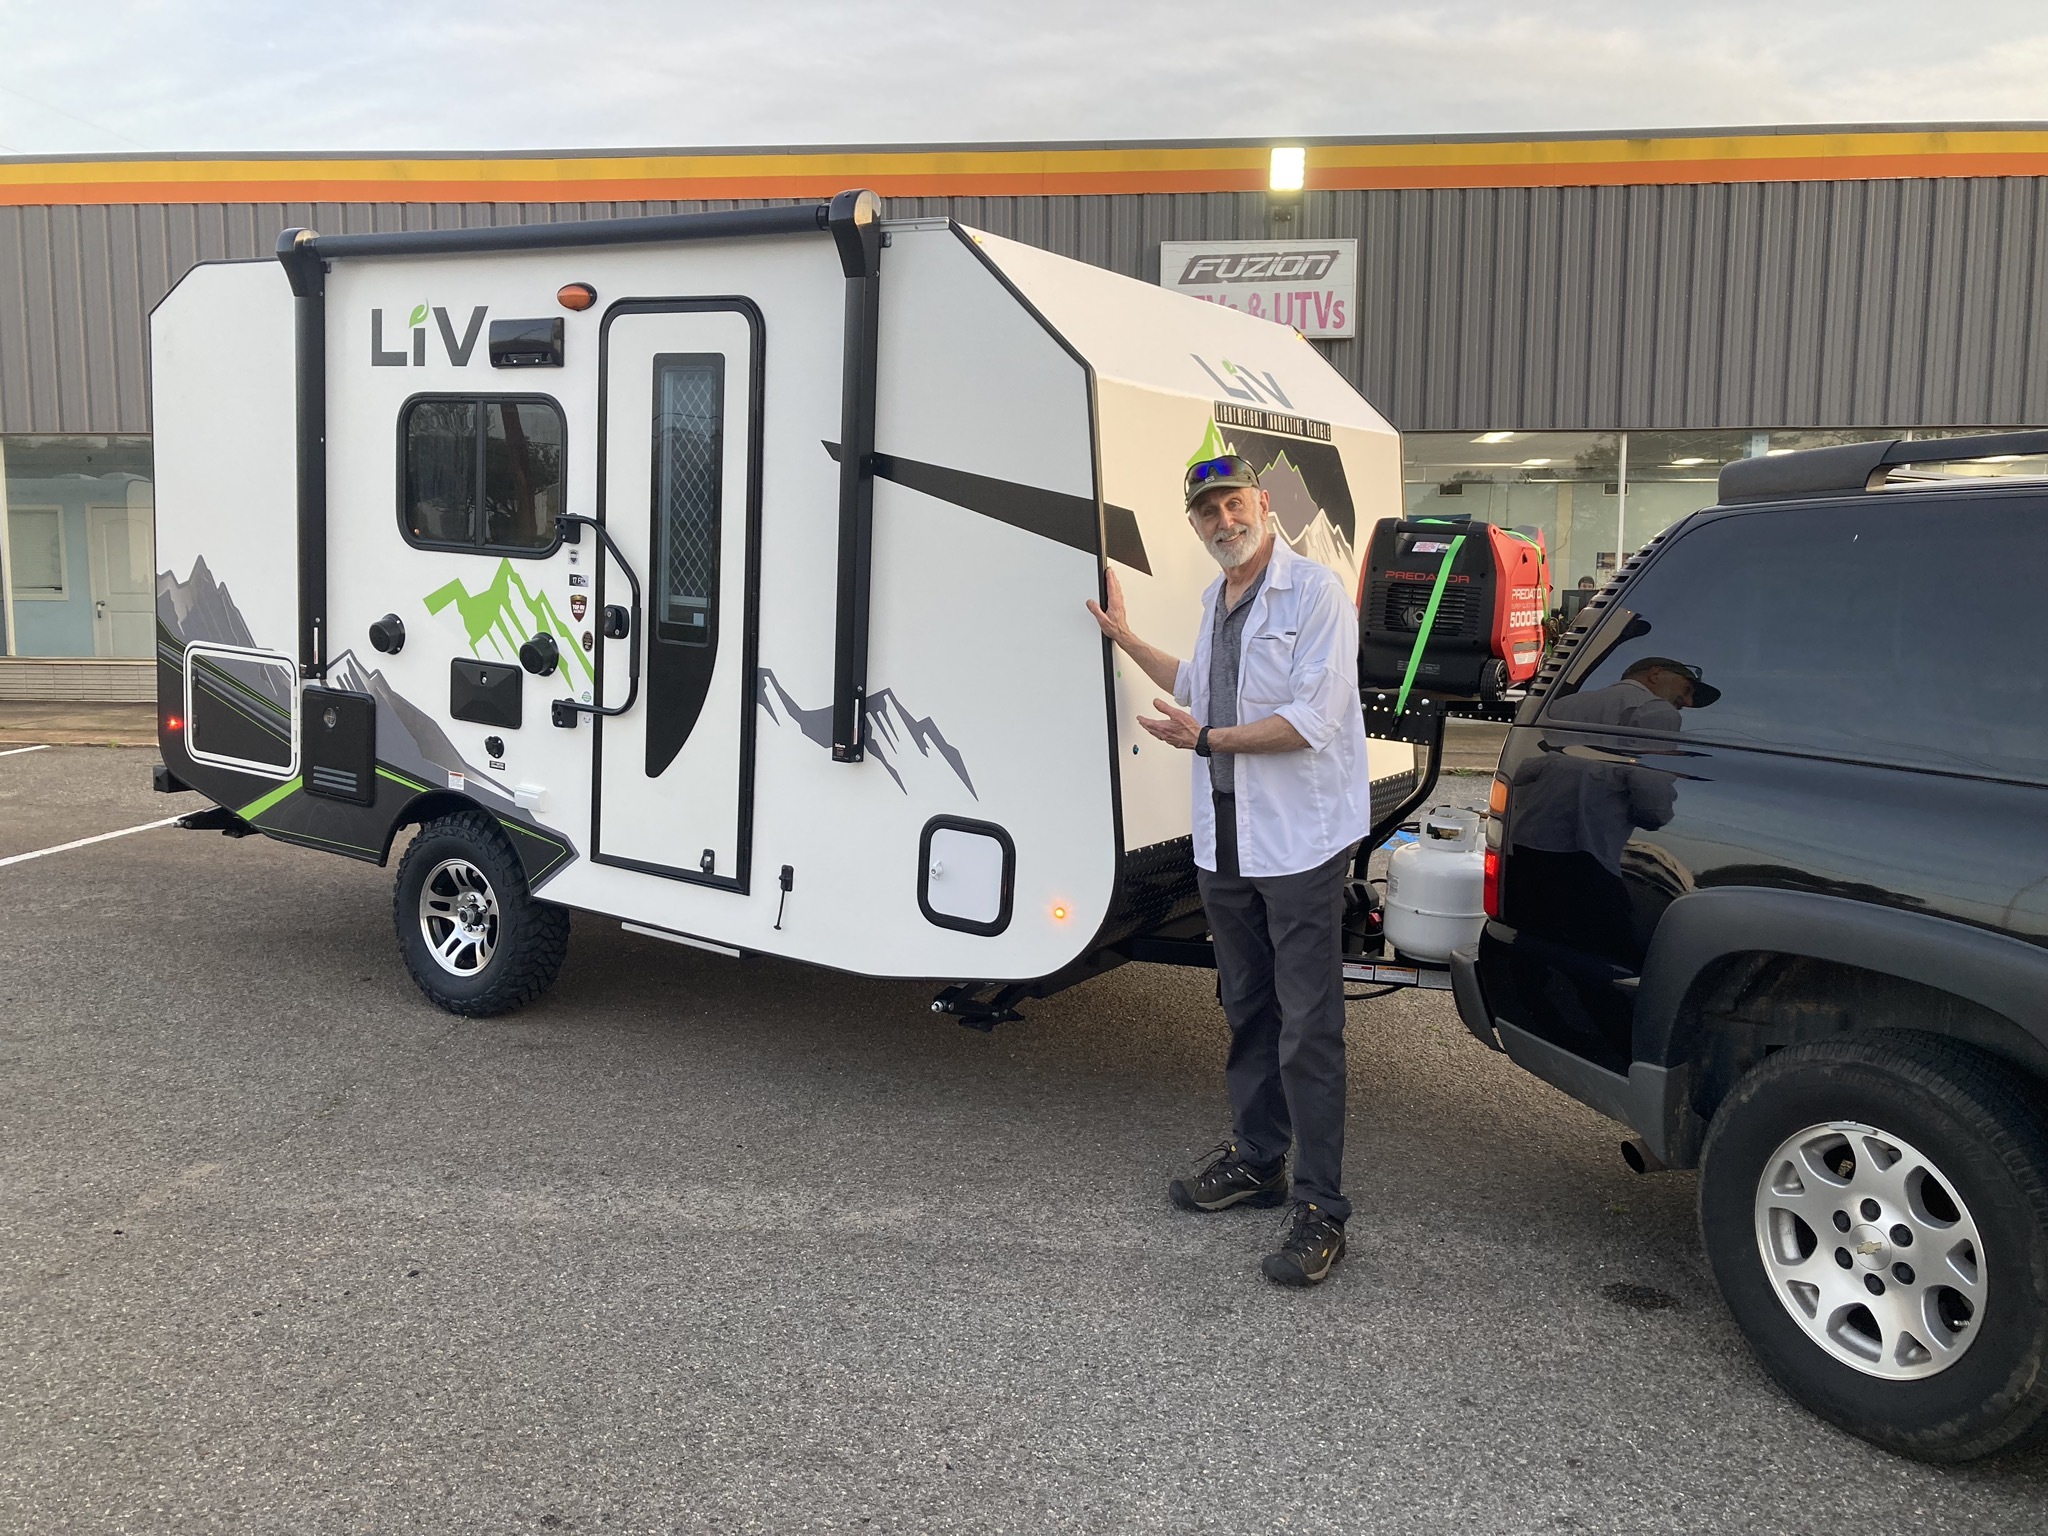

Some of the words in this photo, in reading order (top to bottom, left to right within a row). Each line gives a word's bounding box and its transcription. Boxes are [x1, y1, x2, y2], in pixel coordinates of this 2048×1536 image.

[1187, 254, 1332, 280] FUZION
[1274, 291, 1346, 330] UTVs
[1385, 570, 1470, 584] PREDAOR
